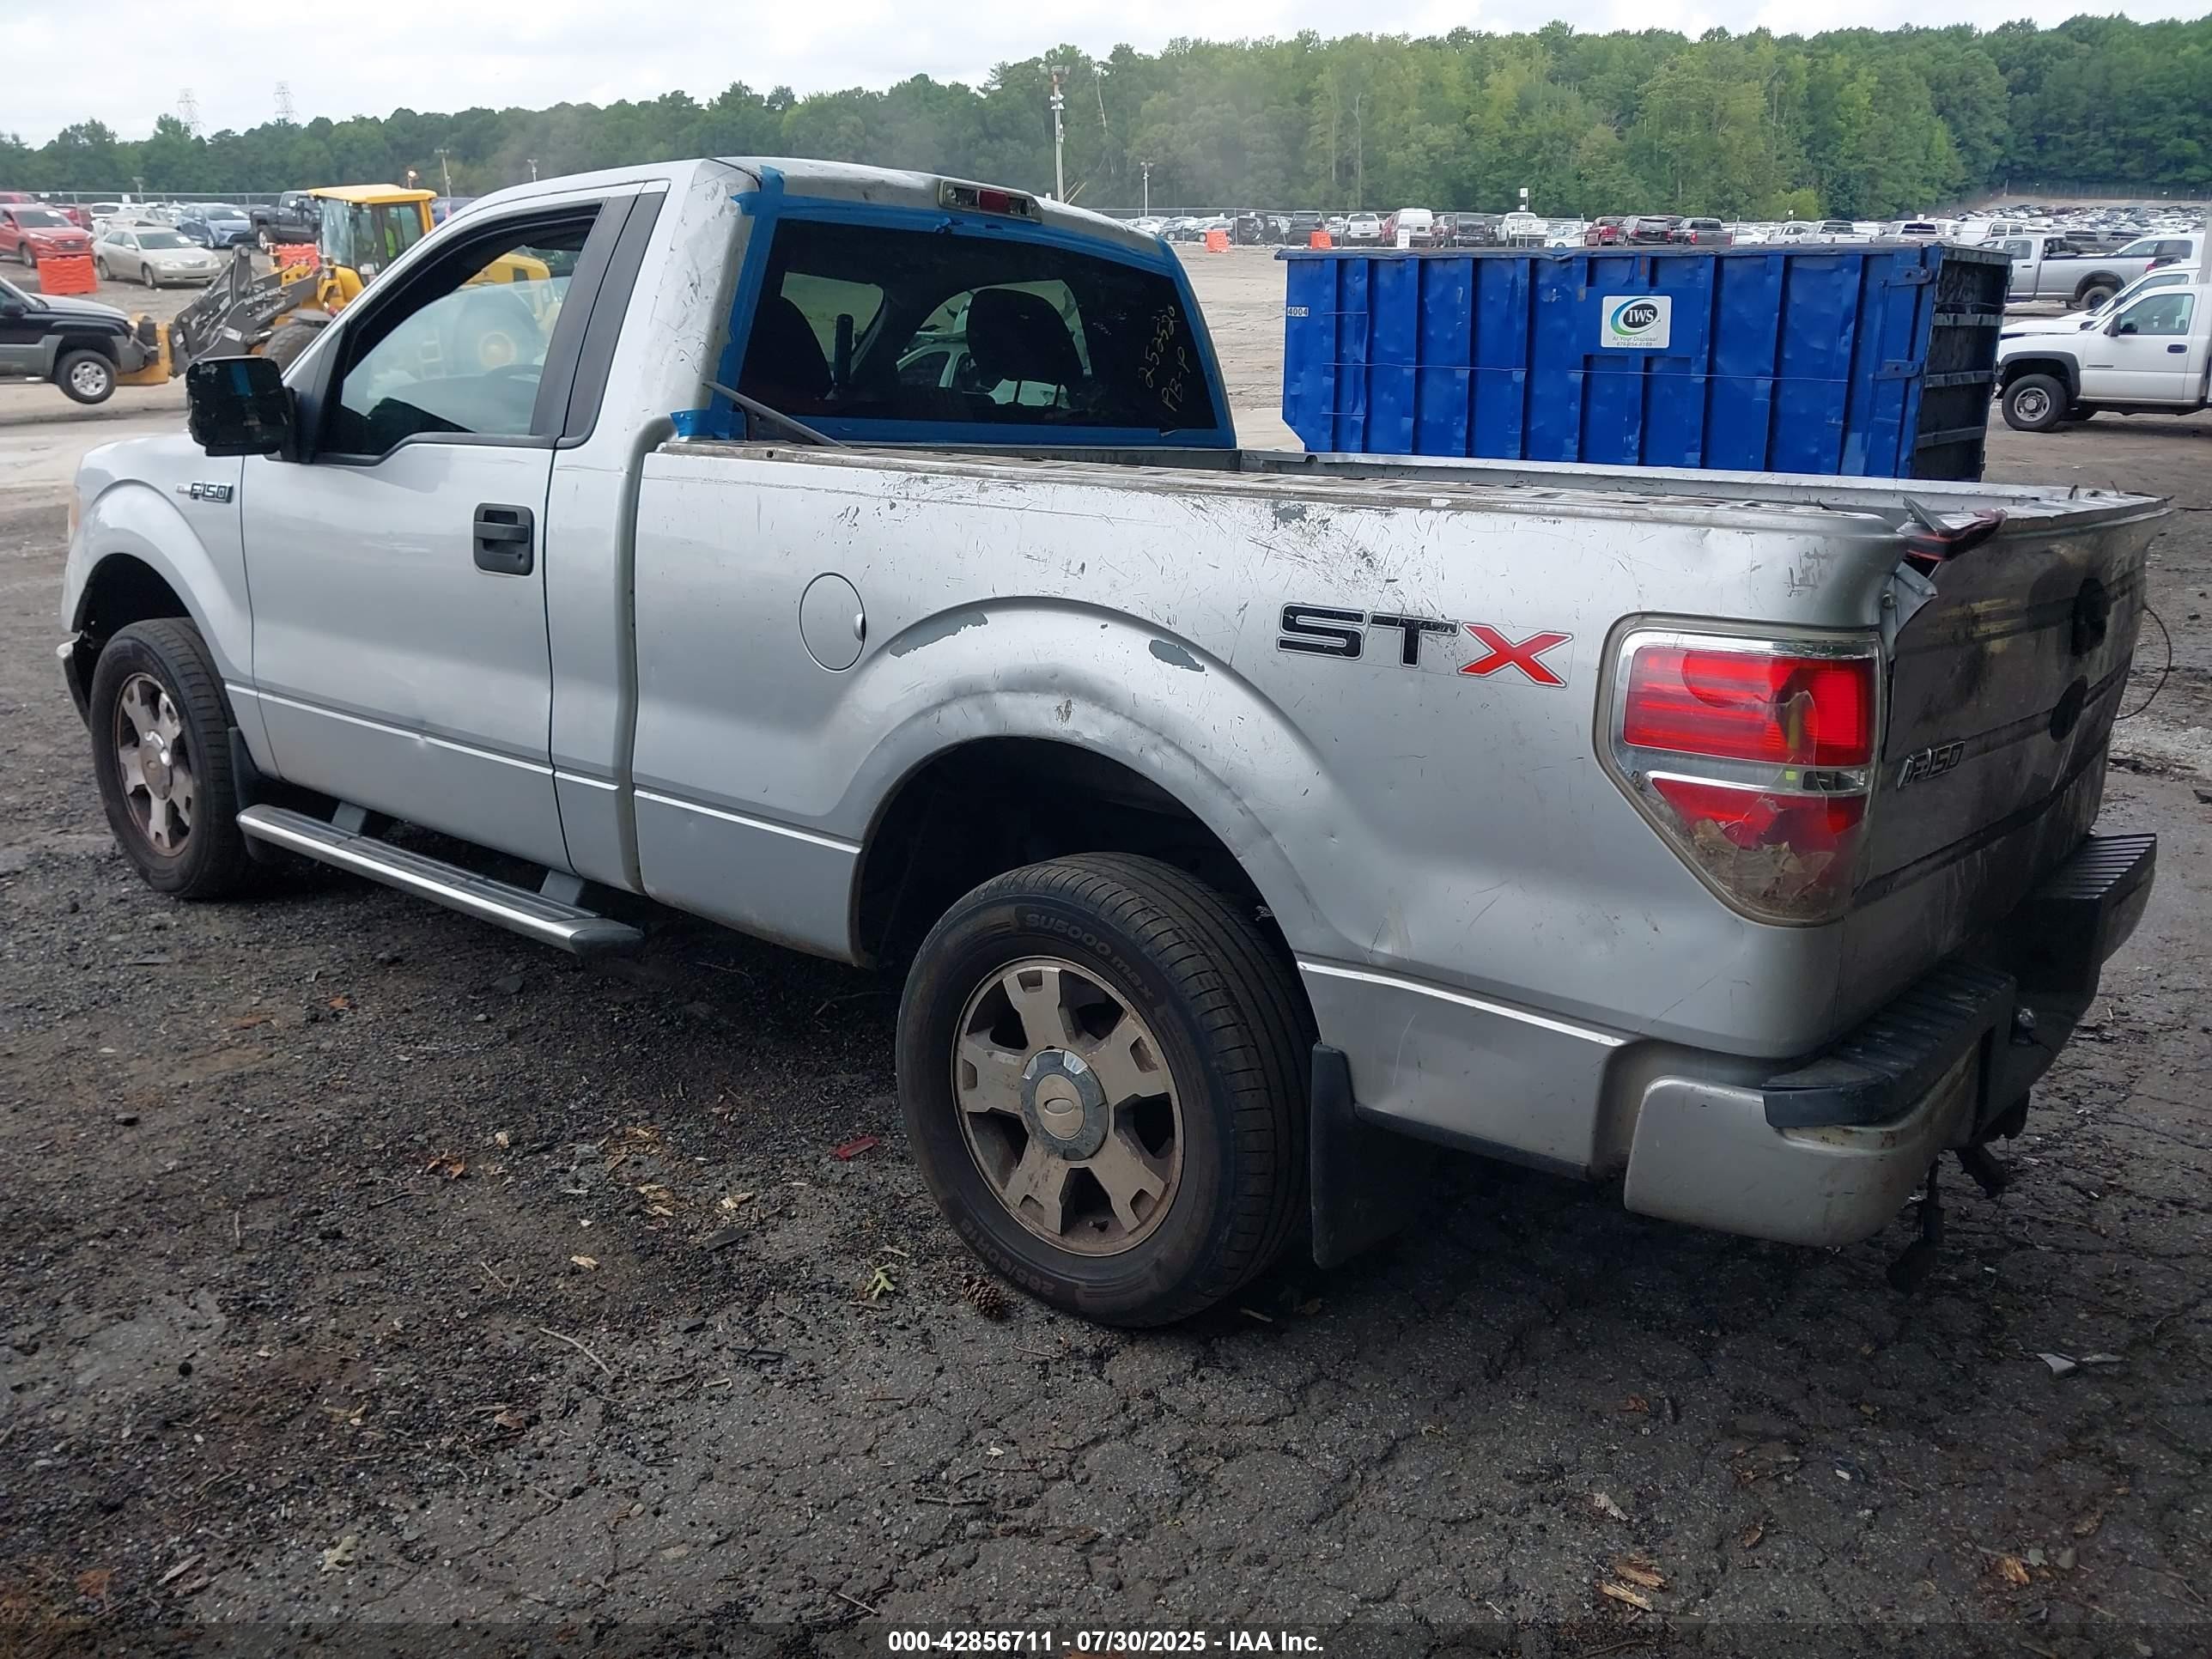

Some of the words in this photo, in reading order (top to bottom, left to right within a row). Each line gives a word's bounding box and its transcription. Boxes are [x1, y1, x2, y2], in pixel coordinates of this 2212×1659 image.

[1288, 307, 1308, 316] 4004
[1627, 308, 1655, 324] IWS
[1277, 602, 1574, 690] STX
